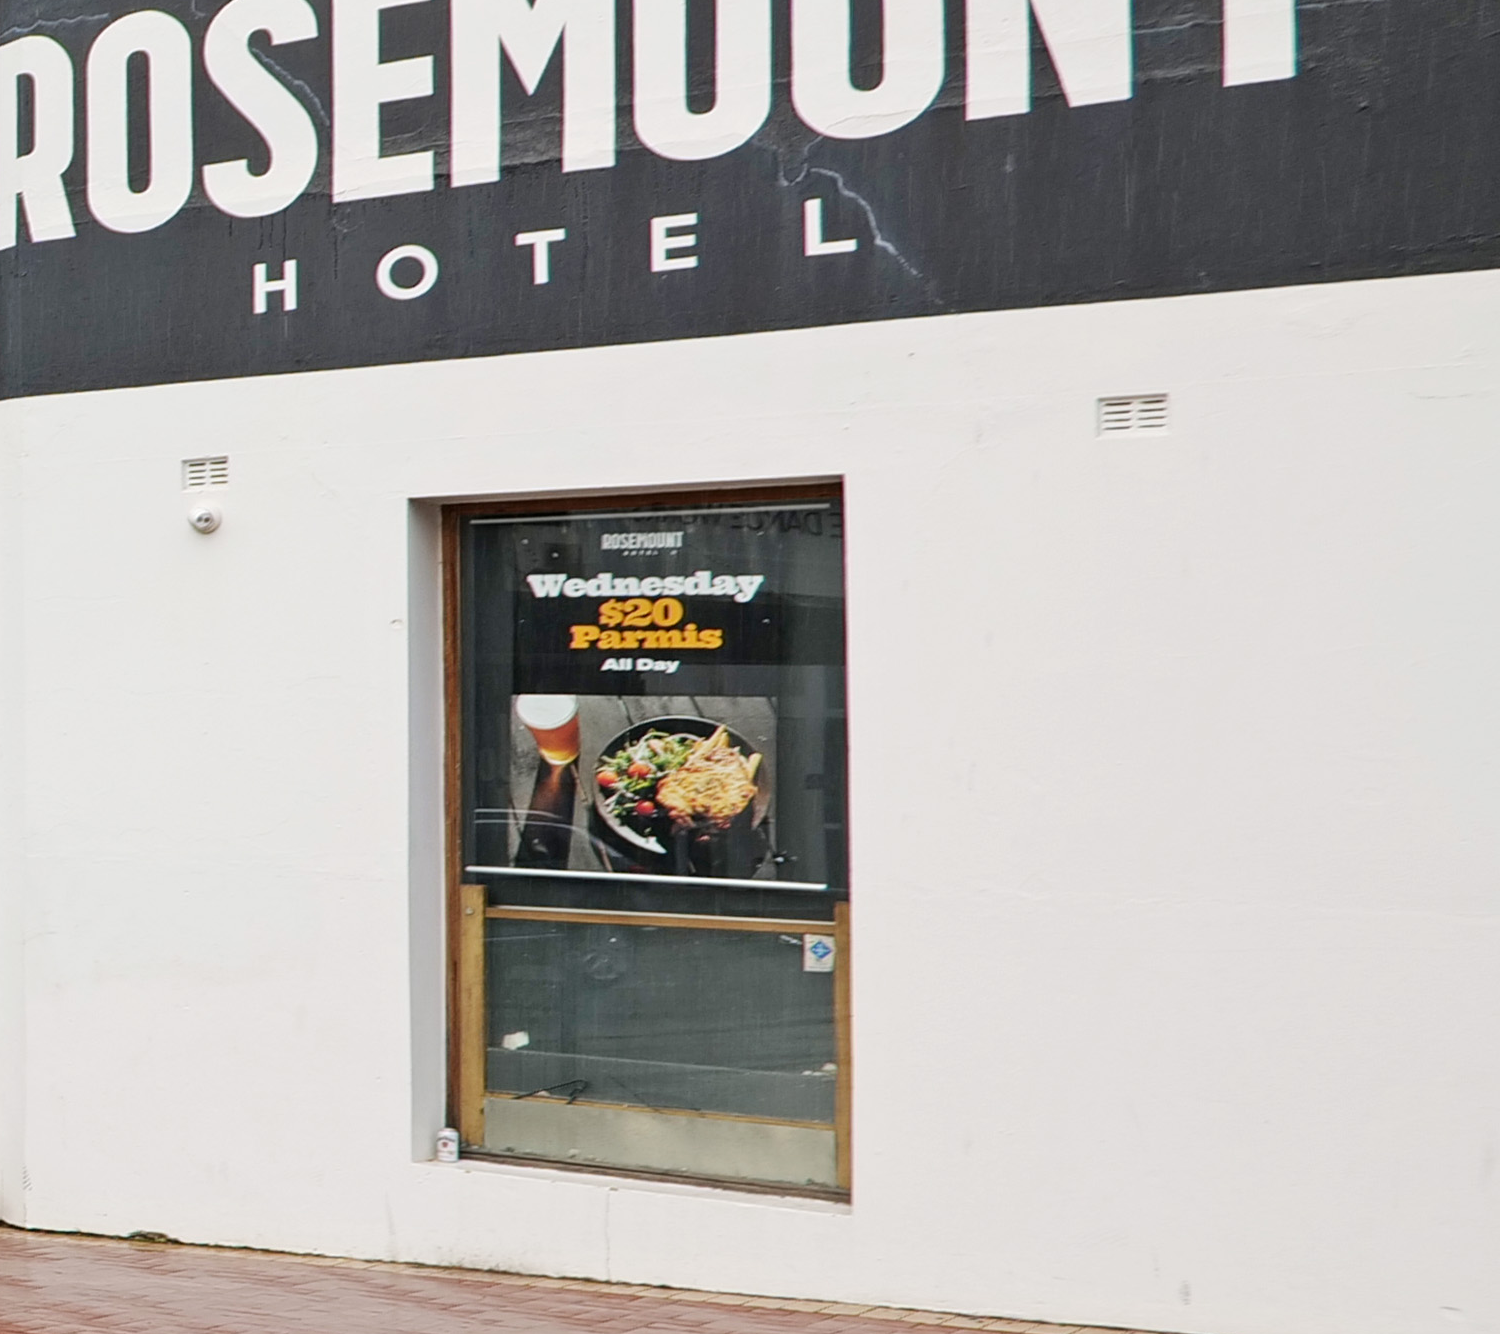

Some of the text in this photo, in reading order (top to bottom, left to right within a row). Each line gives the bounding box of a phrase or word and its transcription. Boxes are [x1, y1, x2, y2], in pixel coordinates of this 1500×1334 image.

[252, 195, 859, 315] HOTEL
[601, 531, 685, 550] ROSEMOUNT
[526, 570, 765, 603] Wednesday
[599, 597, 685, 628] $20
[569, 623, 725, 651] Parmis
[600, 657, 681, 674] All Day
